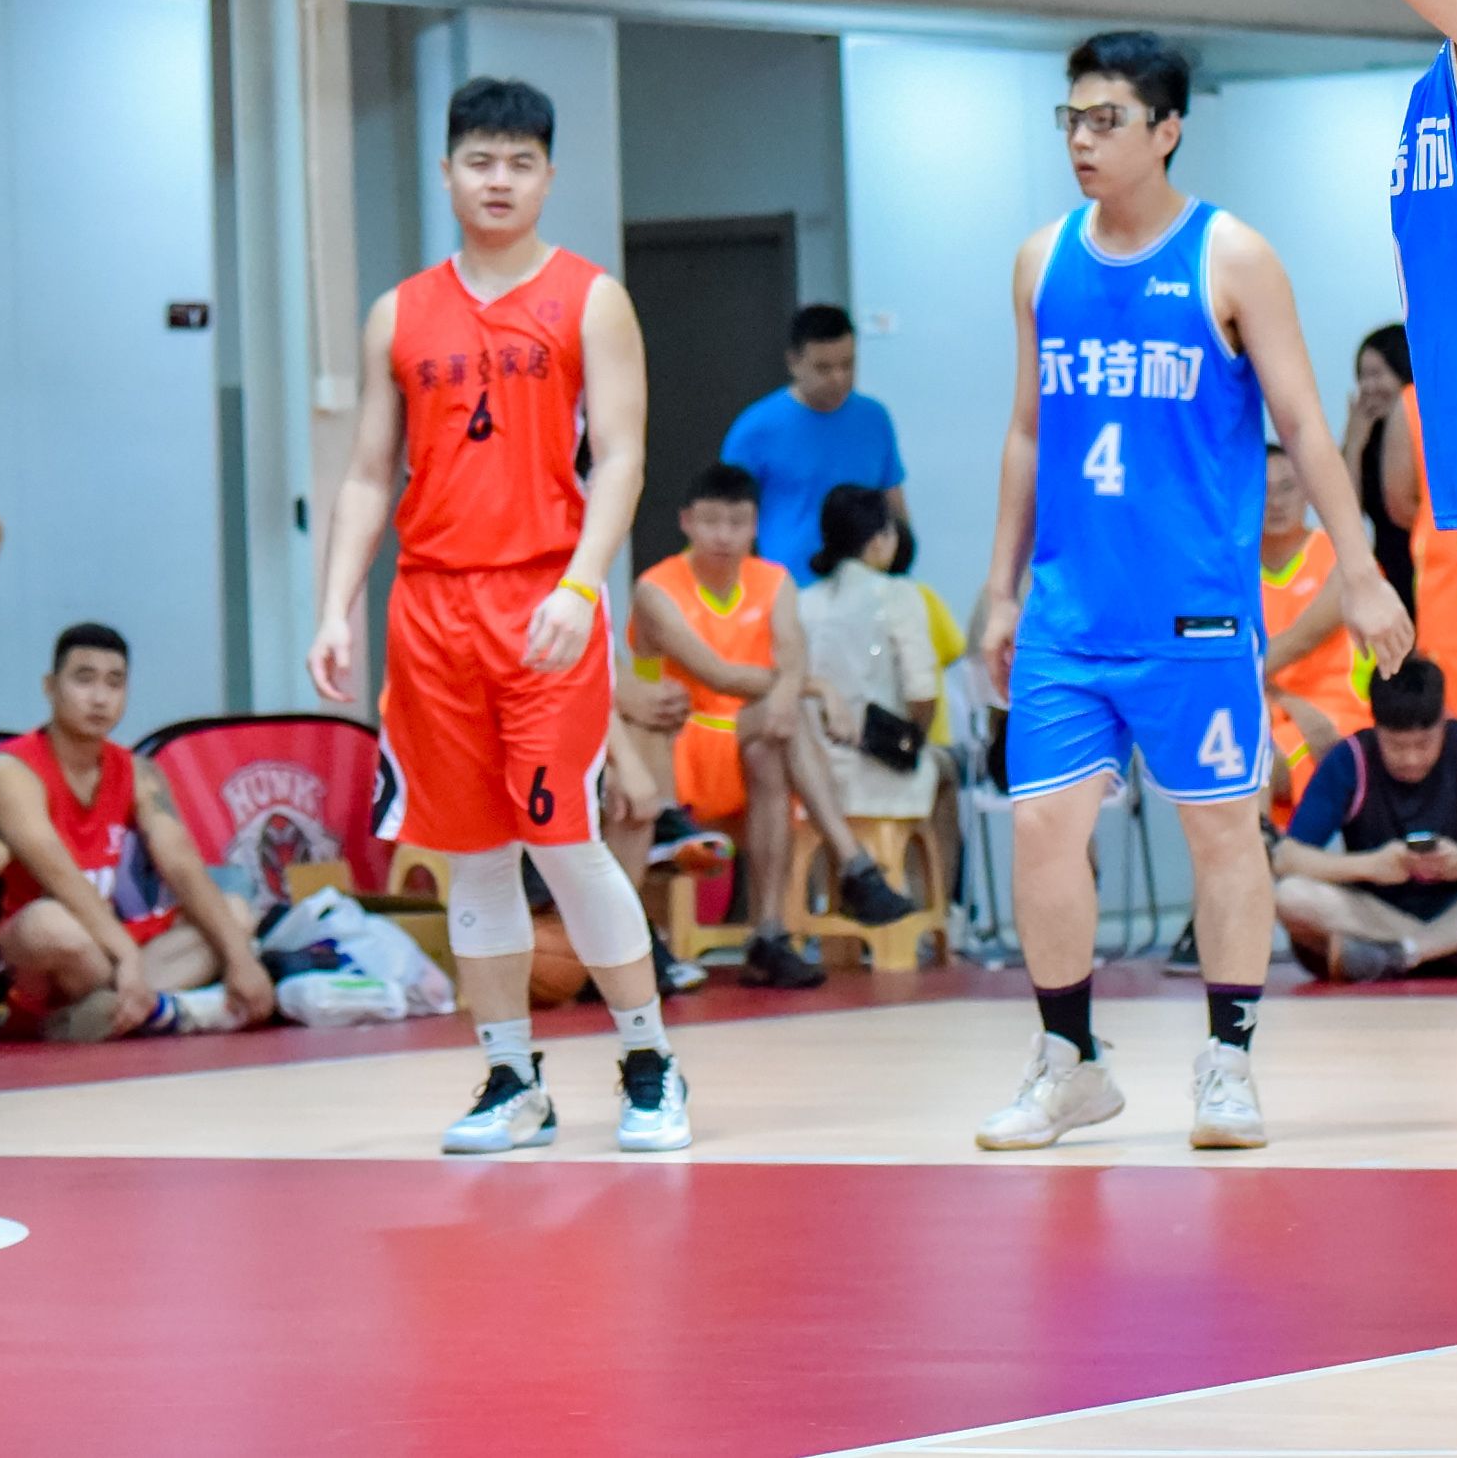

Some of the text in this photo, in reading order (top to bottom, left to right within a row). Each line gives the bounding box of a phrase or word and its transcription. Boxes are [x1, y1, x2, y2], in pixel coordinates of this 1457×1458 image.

[1040, 337, 1205, 402] 永特耐
[467, 390, 493, 442] 6
[1082, 422, 1125, 496] 4
[1197, 707, 1246, 780] 4
[528, 765, 555, 827] 6
